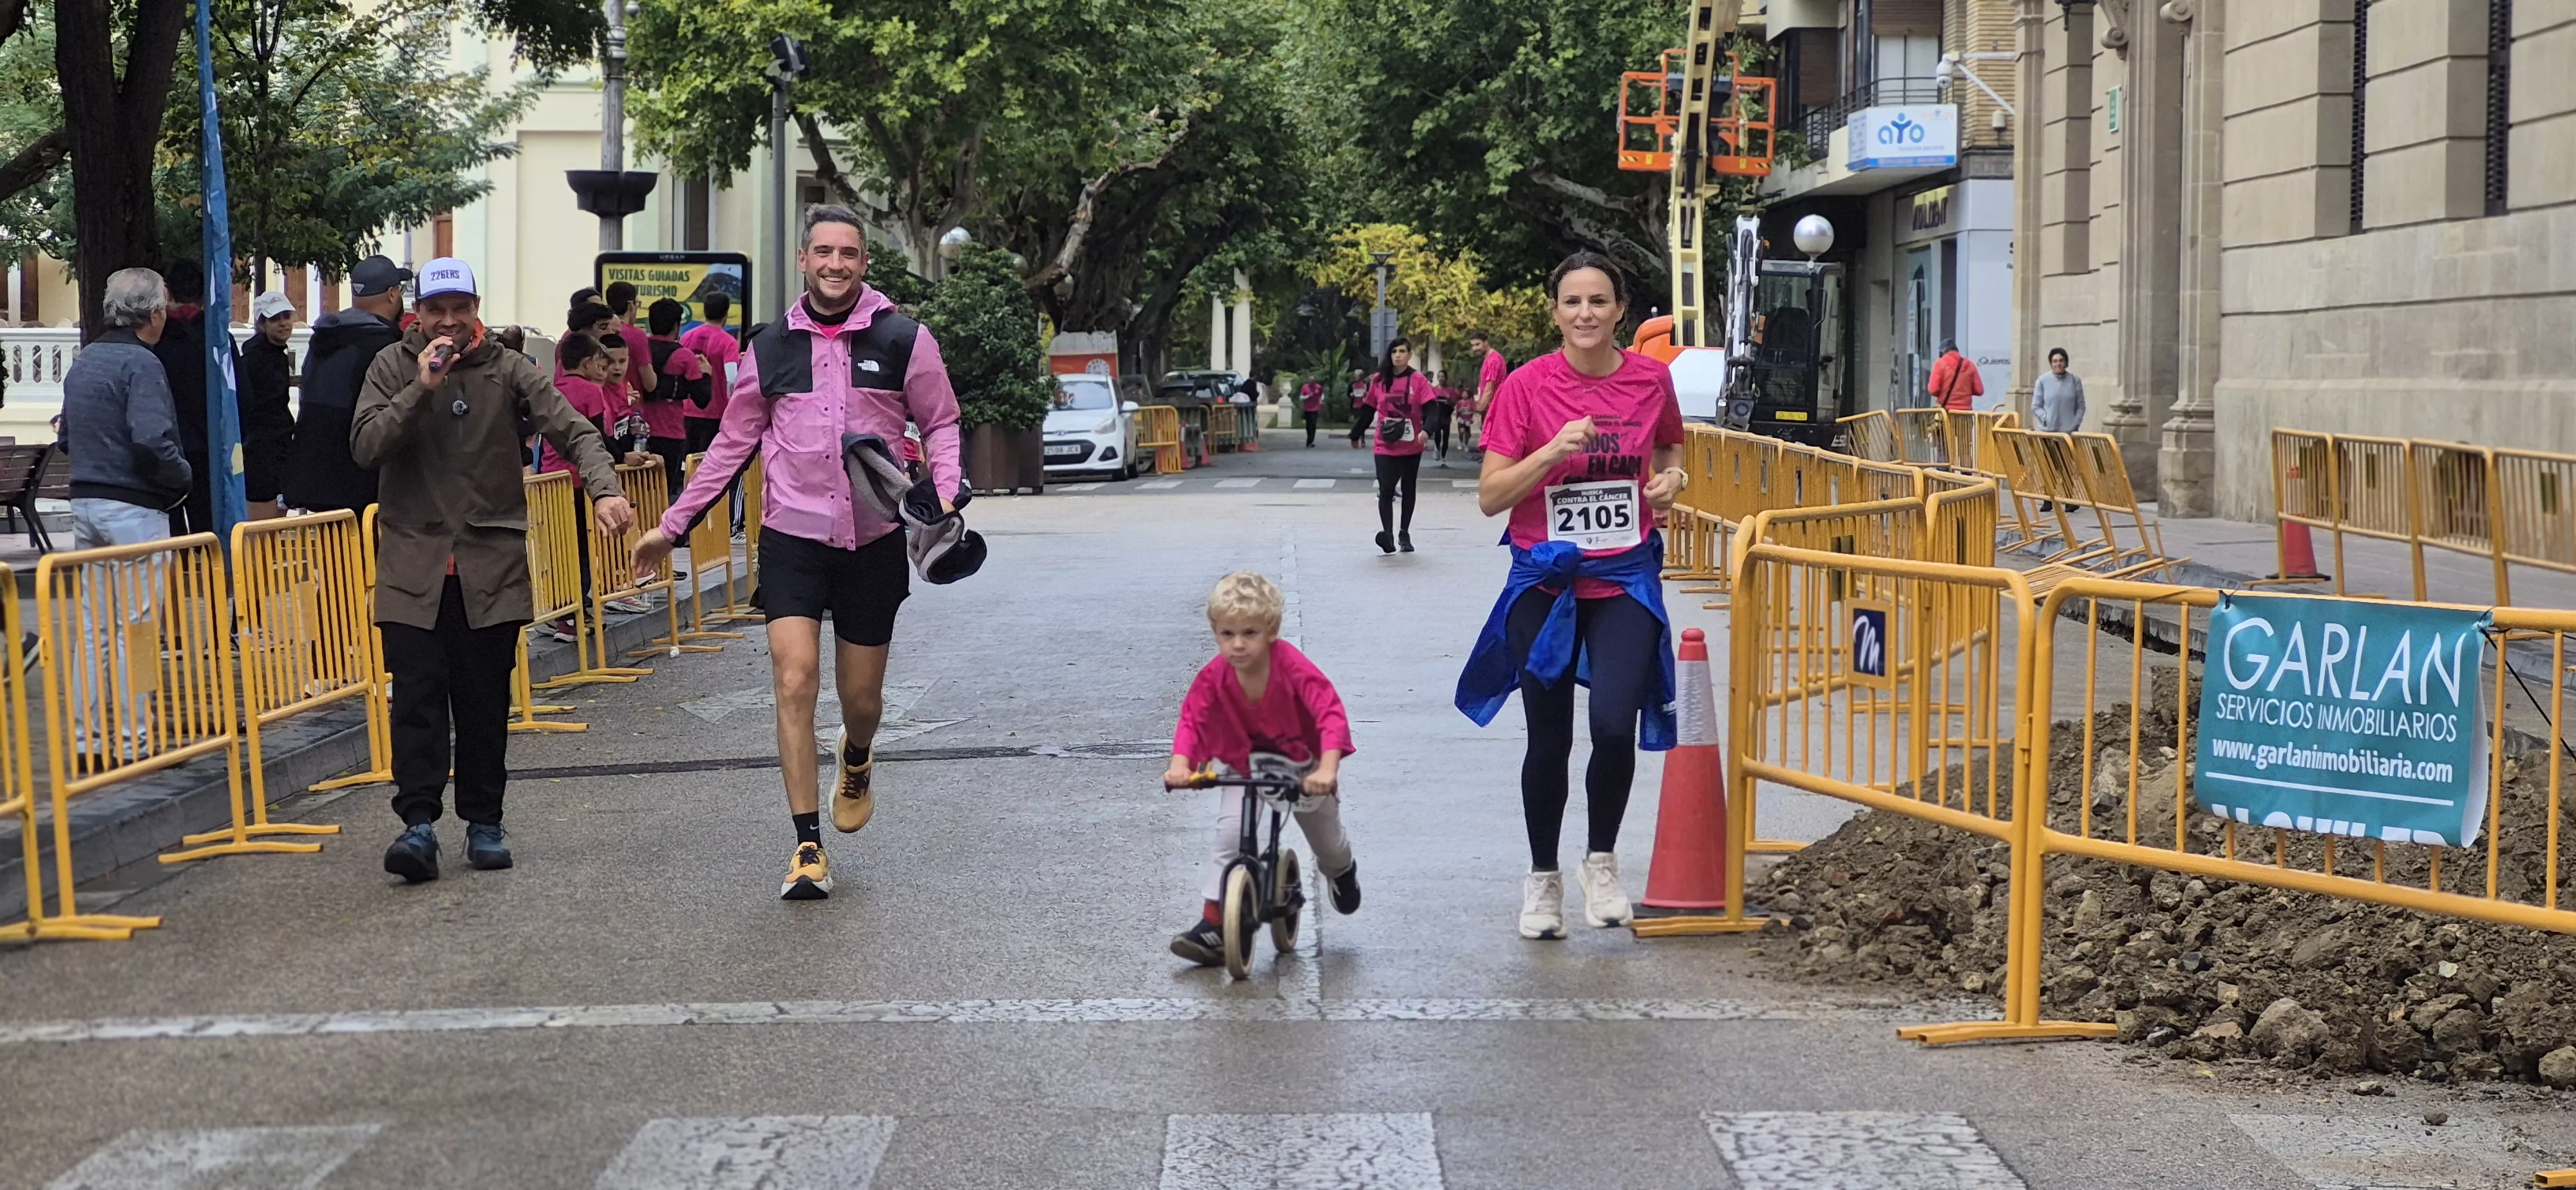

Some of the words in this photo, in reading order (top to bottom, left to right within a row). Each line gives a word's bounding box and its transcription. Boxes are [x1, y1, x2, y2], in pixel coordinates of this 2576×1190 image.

[430, 269, 460, 281] 226ERS
[609, 268, 645, 281] VISITAS
[649, 269, 690, 282] GUIADAS
[1599, 492, 1628, 501] CÁNCER
[1557, 504, 1630, 532] 2105
[2224, 617, 2467, 708] GARLAN
[2216, 692, 2315, 729] SERVICIOS
[2317, 703, 2458, 742] INMOBILIARIOS
[2212, 738, 2453, 784] www.garlaninmobiliaria.com
